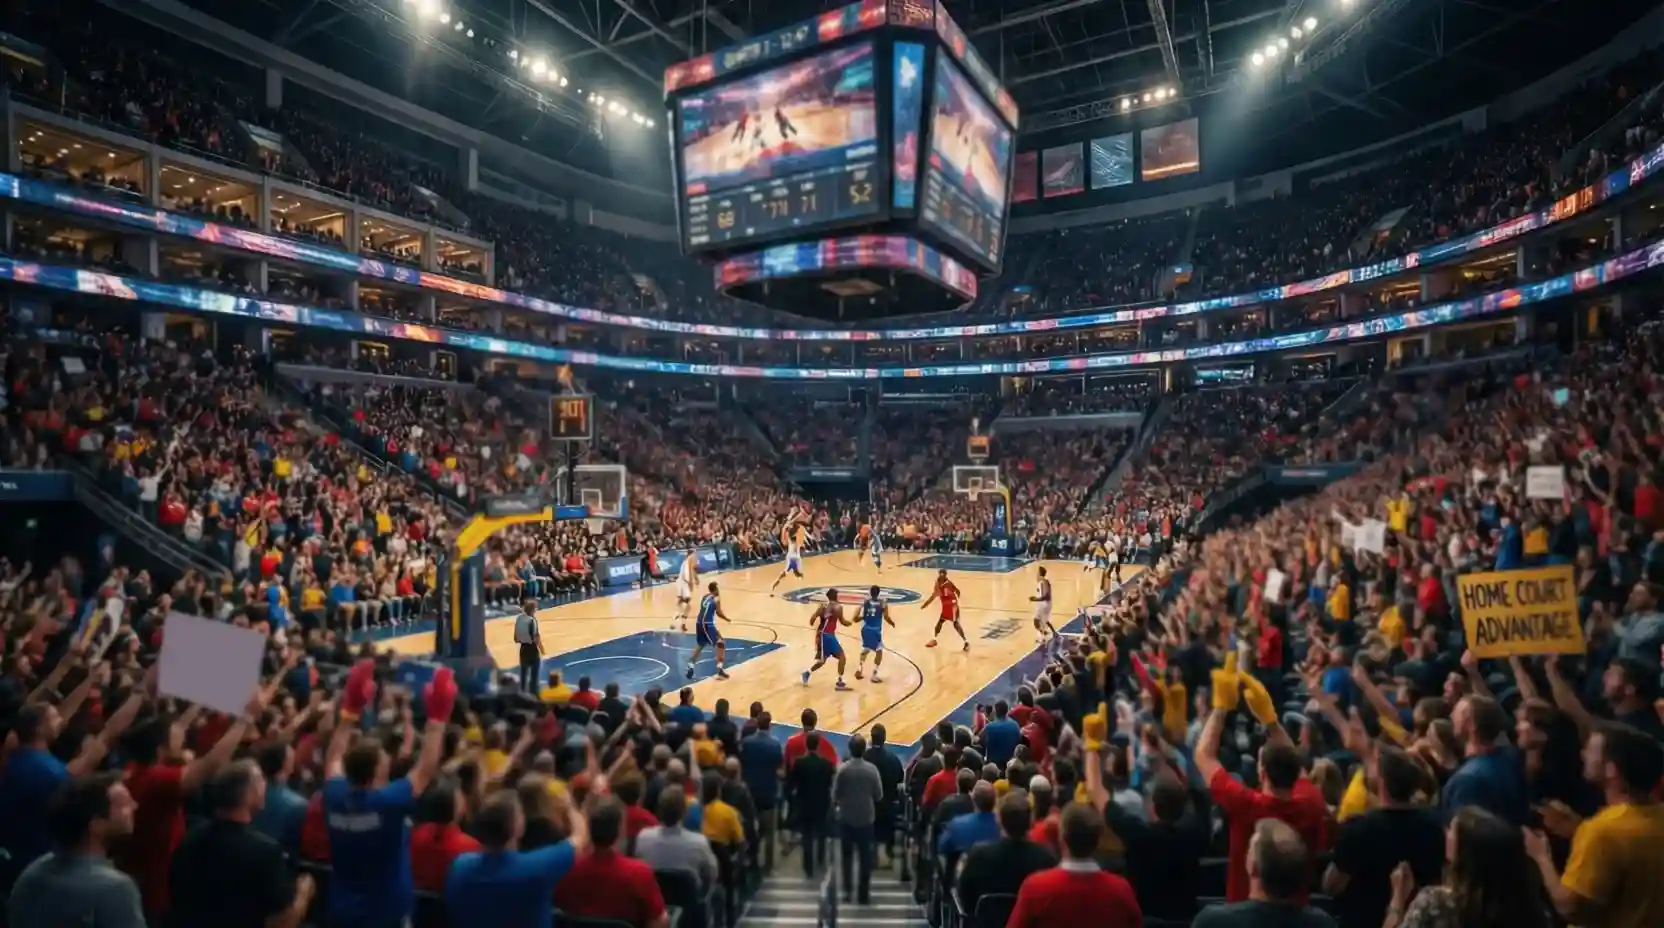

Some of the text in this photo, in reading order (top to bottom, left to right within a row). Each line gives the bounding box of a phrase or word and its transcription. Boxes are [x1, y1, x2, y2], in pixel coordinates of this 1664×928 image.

[1463, 577, 1568, 611] HOME COURT
[1476, 611, 1576, 646] ADVANTAGE
